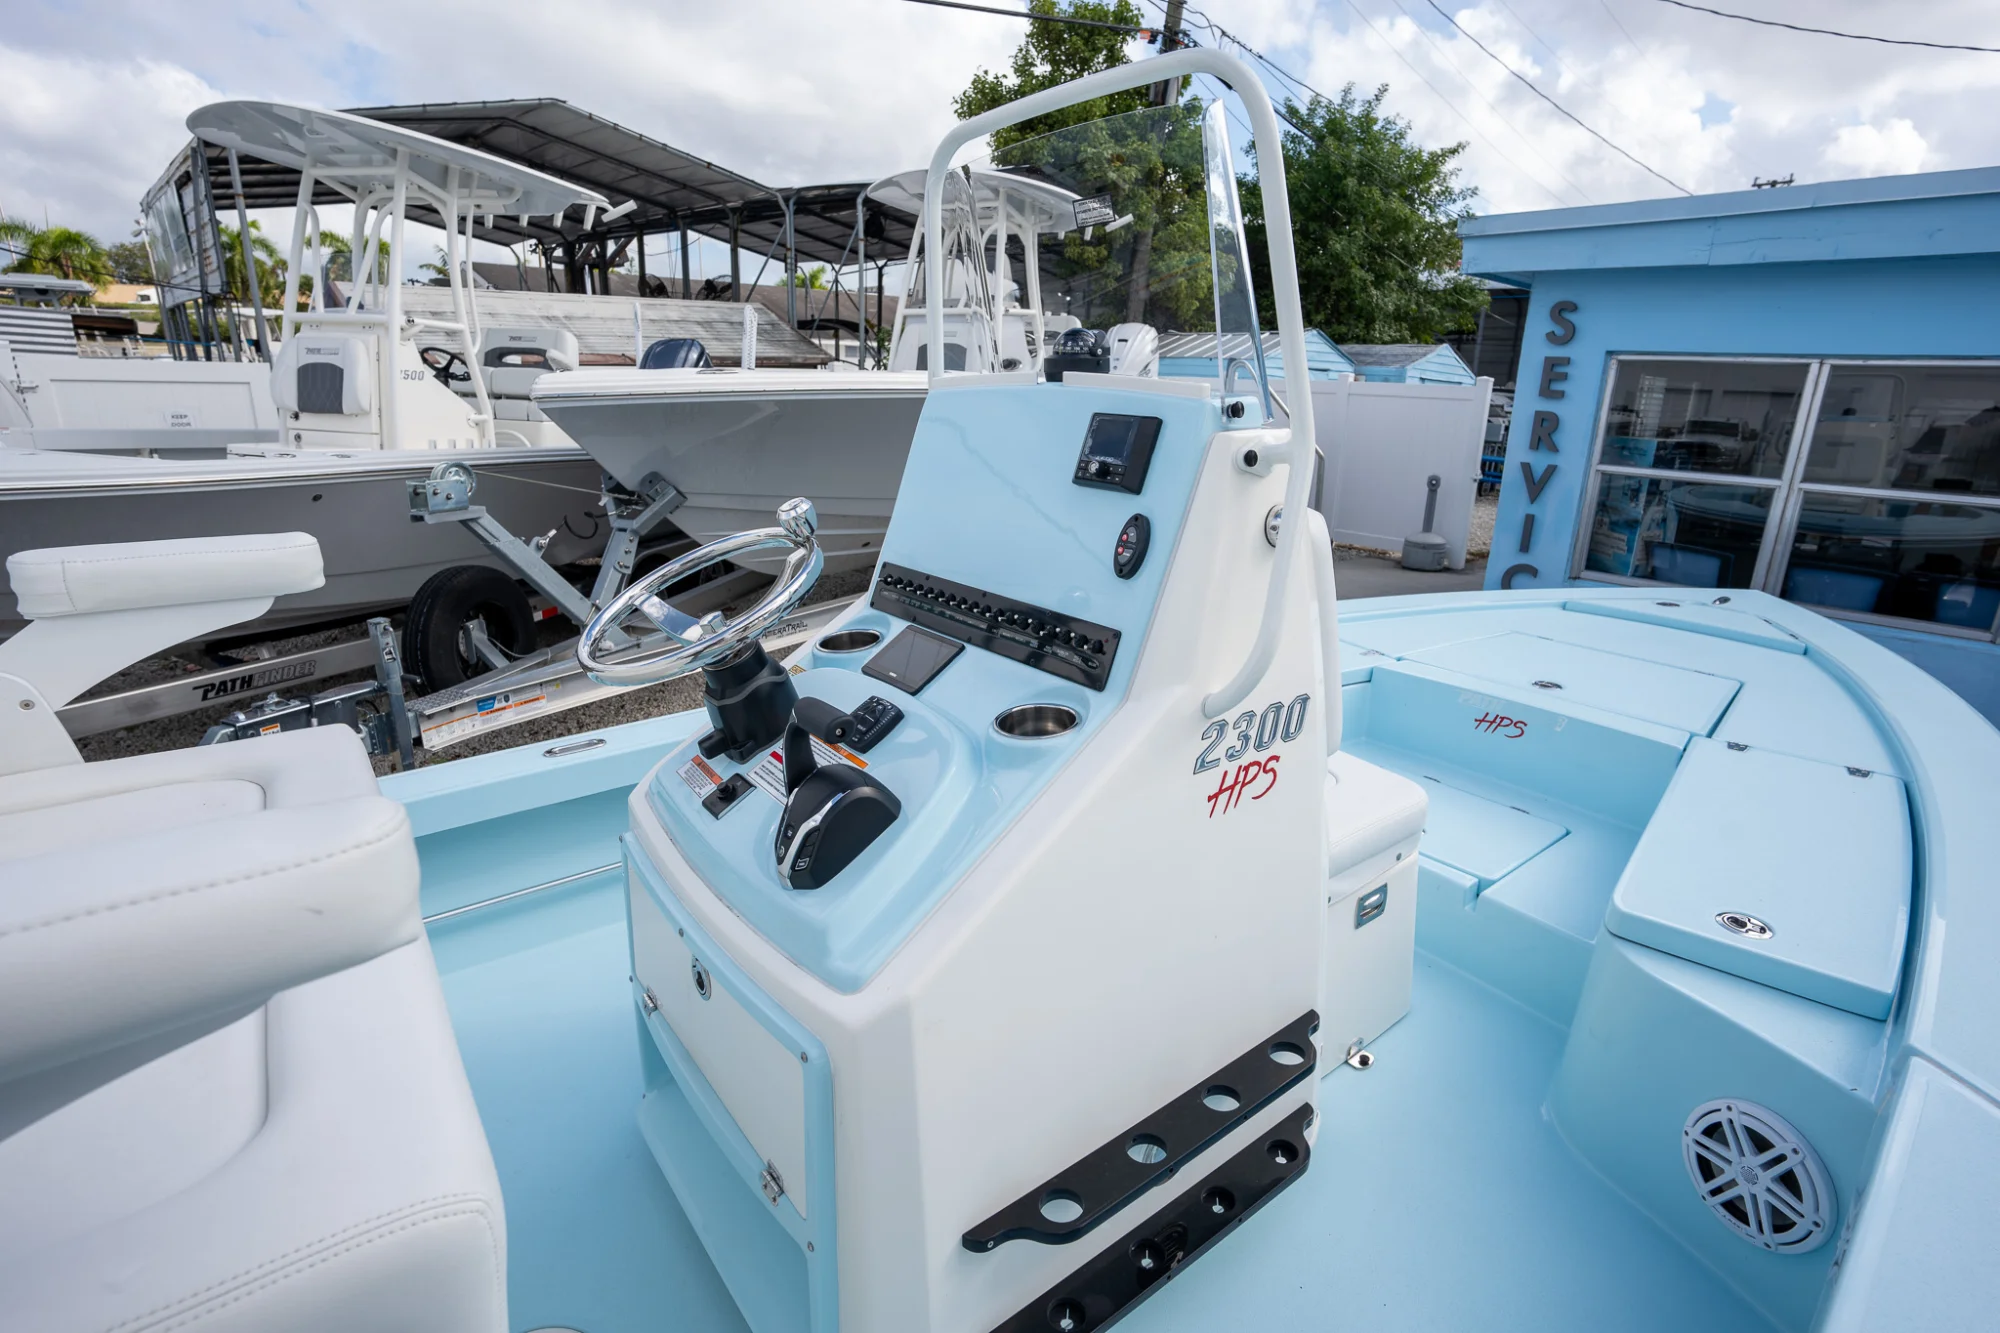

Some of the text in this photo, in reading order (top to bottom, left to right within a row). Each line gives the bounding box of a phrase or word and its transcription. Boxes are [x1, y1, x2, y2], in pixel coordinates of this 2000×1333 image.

[400, 369, 425, 381] 500
[192, 659, 317, 702] PATHFINDER
[1193, 693, 1310, 775] 2300
[1474, 711, 1528, 738] HPS
[1207, 754, 1281, 819] HPS
